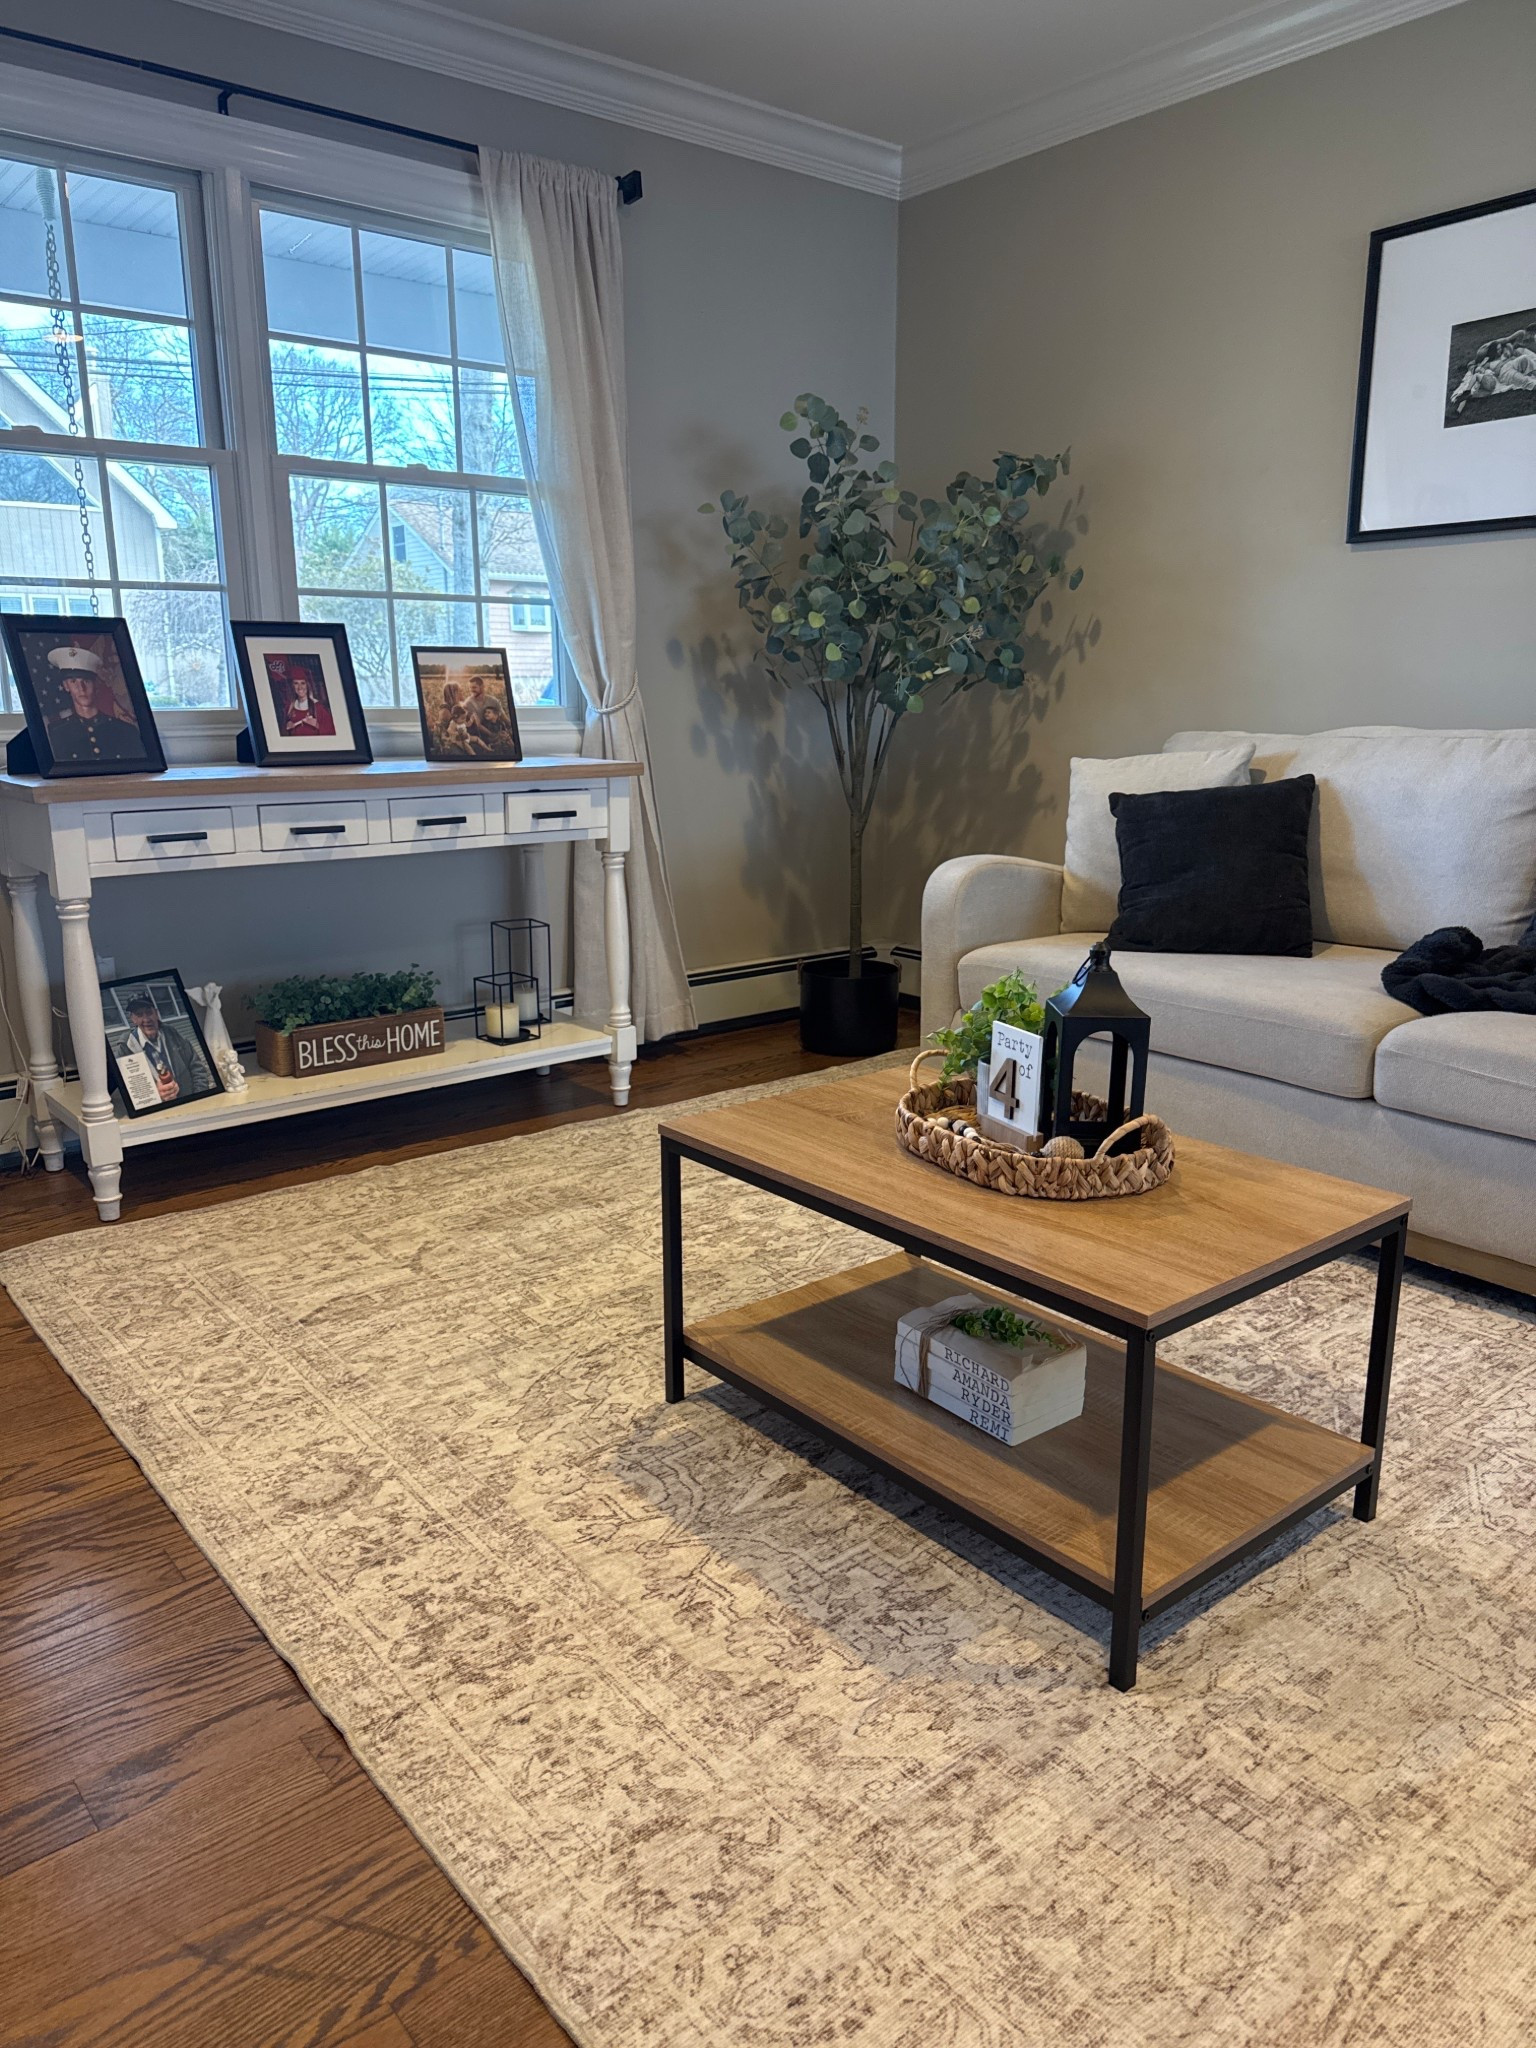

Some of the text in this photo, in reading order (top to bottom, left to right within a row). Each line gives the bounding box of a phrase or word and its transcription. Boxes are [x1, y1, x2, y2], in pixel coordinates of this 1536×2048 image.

[299, 1019, 441, 1069] BLESS this HOME
[997, 1031, 1033, 1059] Party
[989, 1057, 1020, 1120] 4
[1019, 1063, 1034, 1080] of
[944, 1347, 1010, 1392] RICHARD
[952, 1369, 1011, 1411] AMANDA
[961, 1387, 1012, 1426] RYDER
[969, 1409, 1010, 1442] REMI
